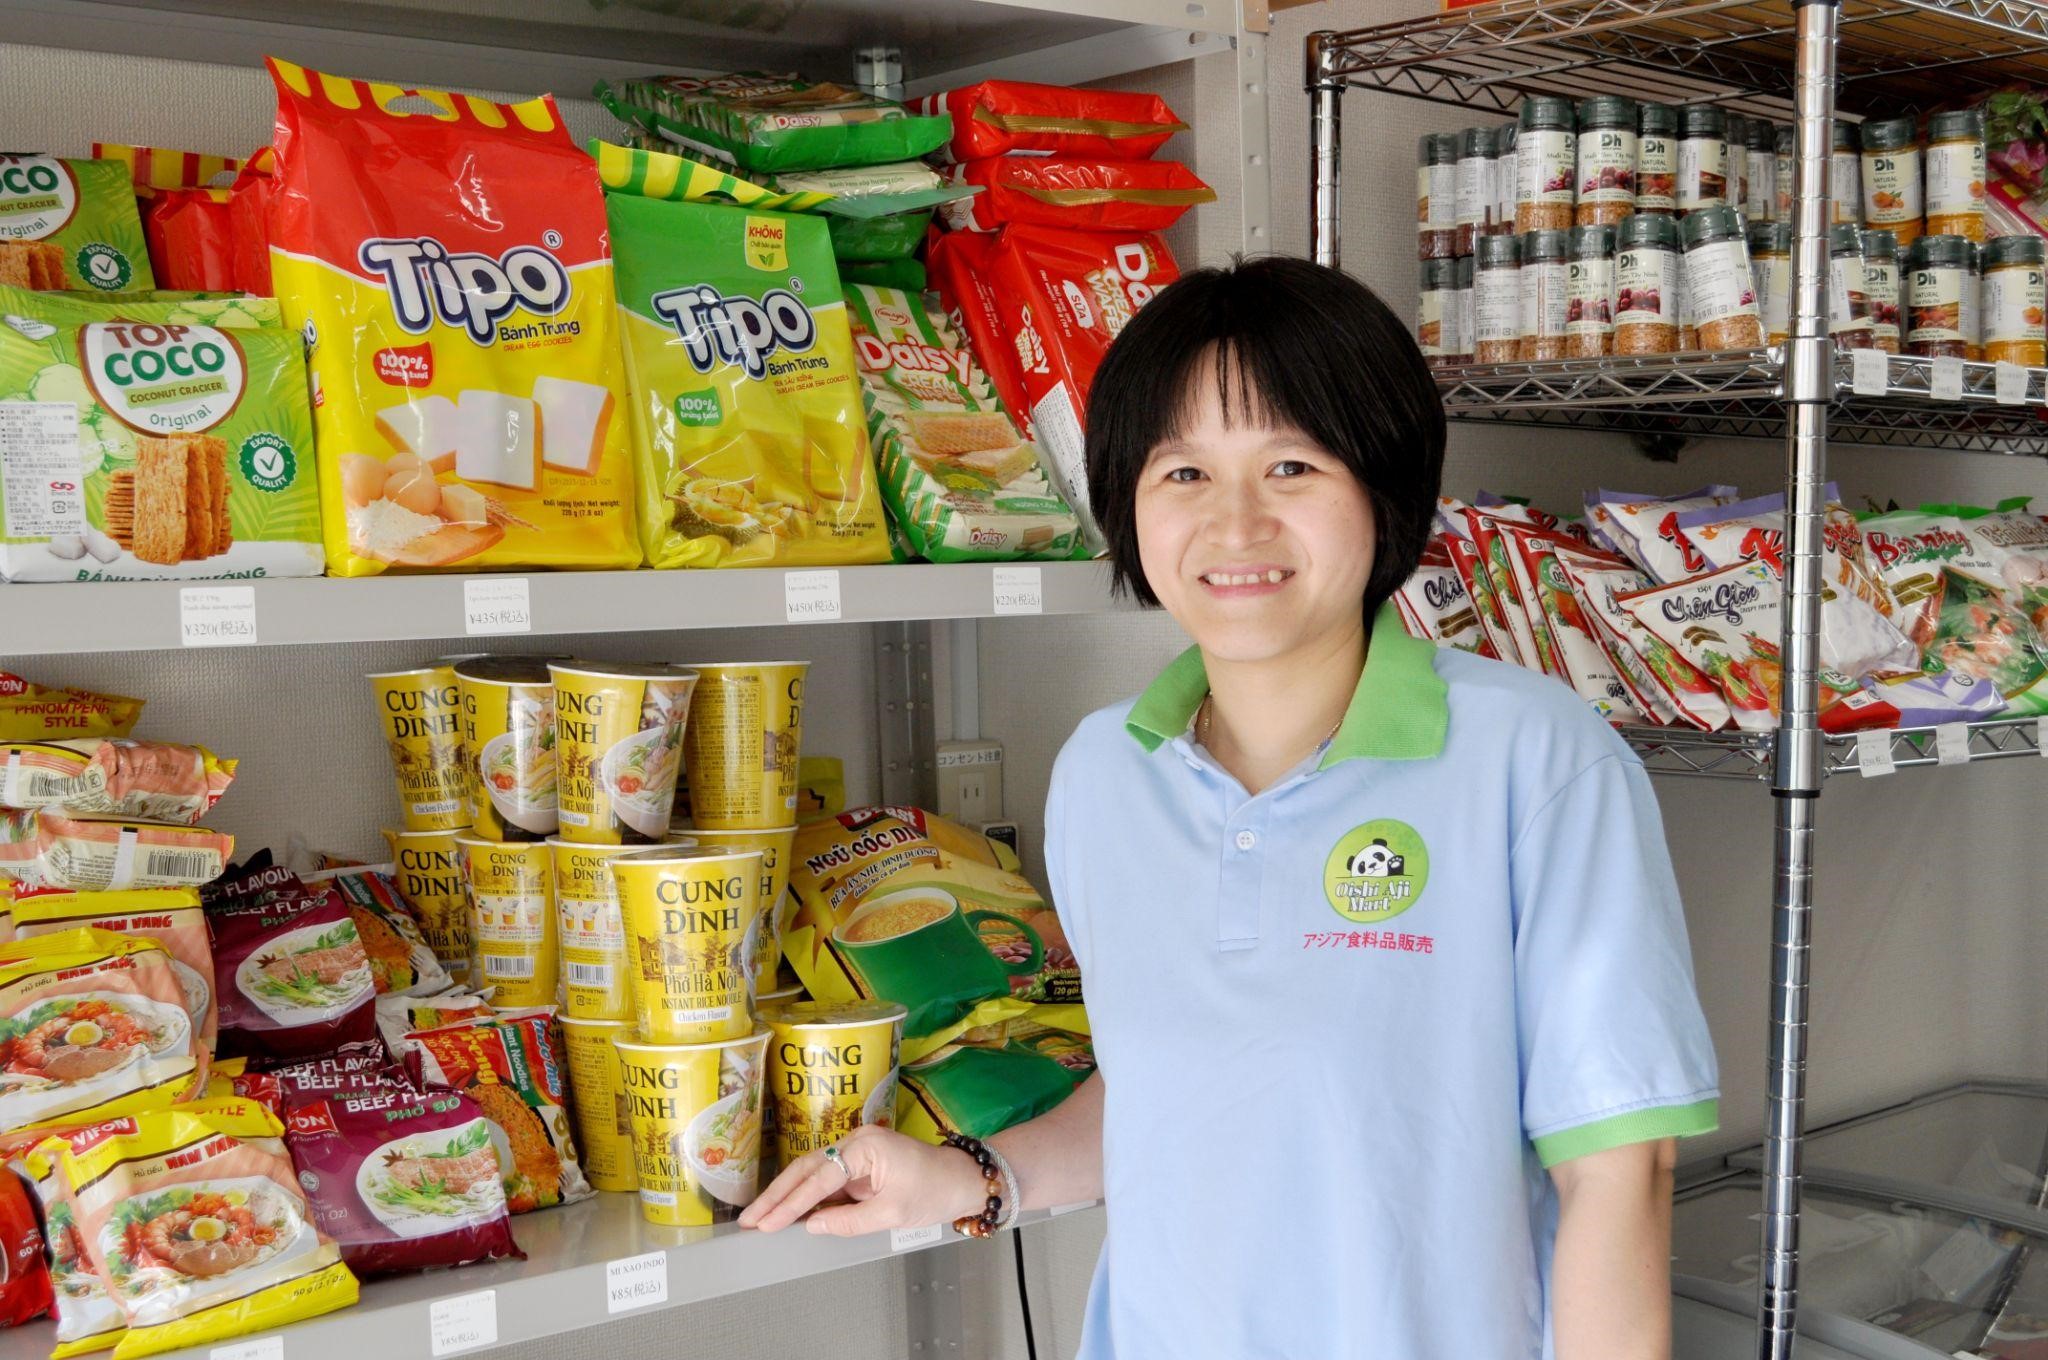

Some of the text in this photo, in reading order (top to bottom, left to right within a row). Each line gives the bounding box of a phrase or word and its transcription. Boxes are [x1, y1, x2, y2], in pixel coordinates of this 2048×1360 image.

[775, 114, 822, 130] Daisy
[1602, 134, 1622, 147] Dh
[1645, 140, 1665, 153] Dh
[1874, 158, 1895, 171] Dh
[17, 198, 57, 211] CRACKER
[86, 243, 118, 257] EXPORT
[1620, 254, 1639, 268] Dh
[89, 276, 123, 289] QUALITY
[1867, 268, 1888, 282] Dh
[1917, 272, 1937, 286] Dh
[500, 323, 538, 341] Bánh
[1021, 304, 1050, 374] Daisy
[104, 341, 226, 386] COCO
[379, 352, 428, 370] 100%
[769, 359, 797, 376] Bánh
[854, 335, 972, 388] Daisy
[130, 381, 223, 403] COCONUT CRACKER
[678, 398, 718, 412] 100%
[149, 404, 213, 430] Original
[249, 435, 286, 450] EXPORT
[251, 475, 288, 489] QUALITY
[969, 528, 1008, 547] Daisy
[385, 686, 459, 713] CUNG
[555, 689, 604, 717] UNG
[44, 716, 88, 728] STYLE
[393, 712, 459, 738] ĐÌNH
[490, 853, 527, 864] CUNG
[806, 828, 893, 877] NGŨ CỐC
[882, 853, 904, 868] DINH
[656, 877, 743, 905] CUNG
[1335, 879, 1411, 900] Oishi Aji
[1347, 897, 1391, 912] Mart
[132, 914, 173, 930] VANG
[664, 906, 741, 935] ĐÌNH
[1303, 930, 1434, 954] アジア食料品販売
[665, 971, 737, 994] Phở Hà Nội
[661, 991, 742, 1010] INSTANT RICE NOODLE
[678, 1010, 706, 1023] Chicken
[780, 1043, 863, 1069] CUNG
[511, 1049, 529, 1091] Noodles
[297, 1074, 345, 1091] BEEF
[784, 1070, 859, 1097] ĐÌNH
[346, 1094, 396, 1114] BEEF
[72, 1117, 131, 1147] VIFON
[165, 1148, 202, 1170] NAM
[641, 1155, 680, 1178] Hà Nội
[659, 1179, 688, 1193] NOODLE
[19, 1245, 34, 1259] 60
[642, 1256, 666, 1271] INDO
